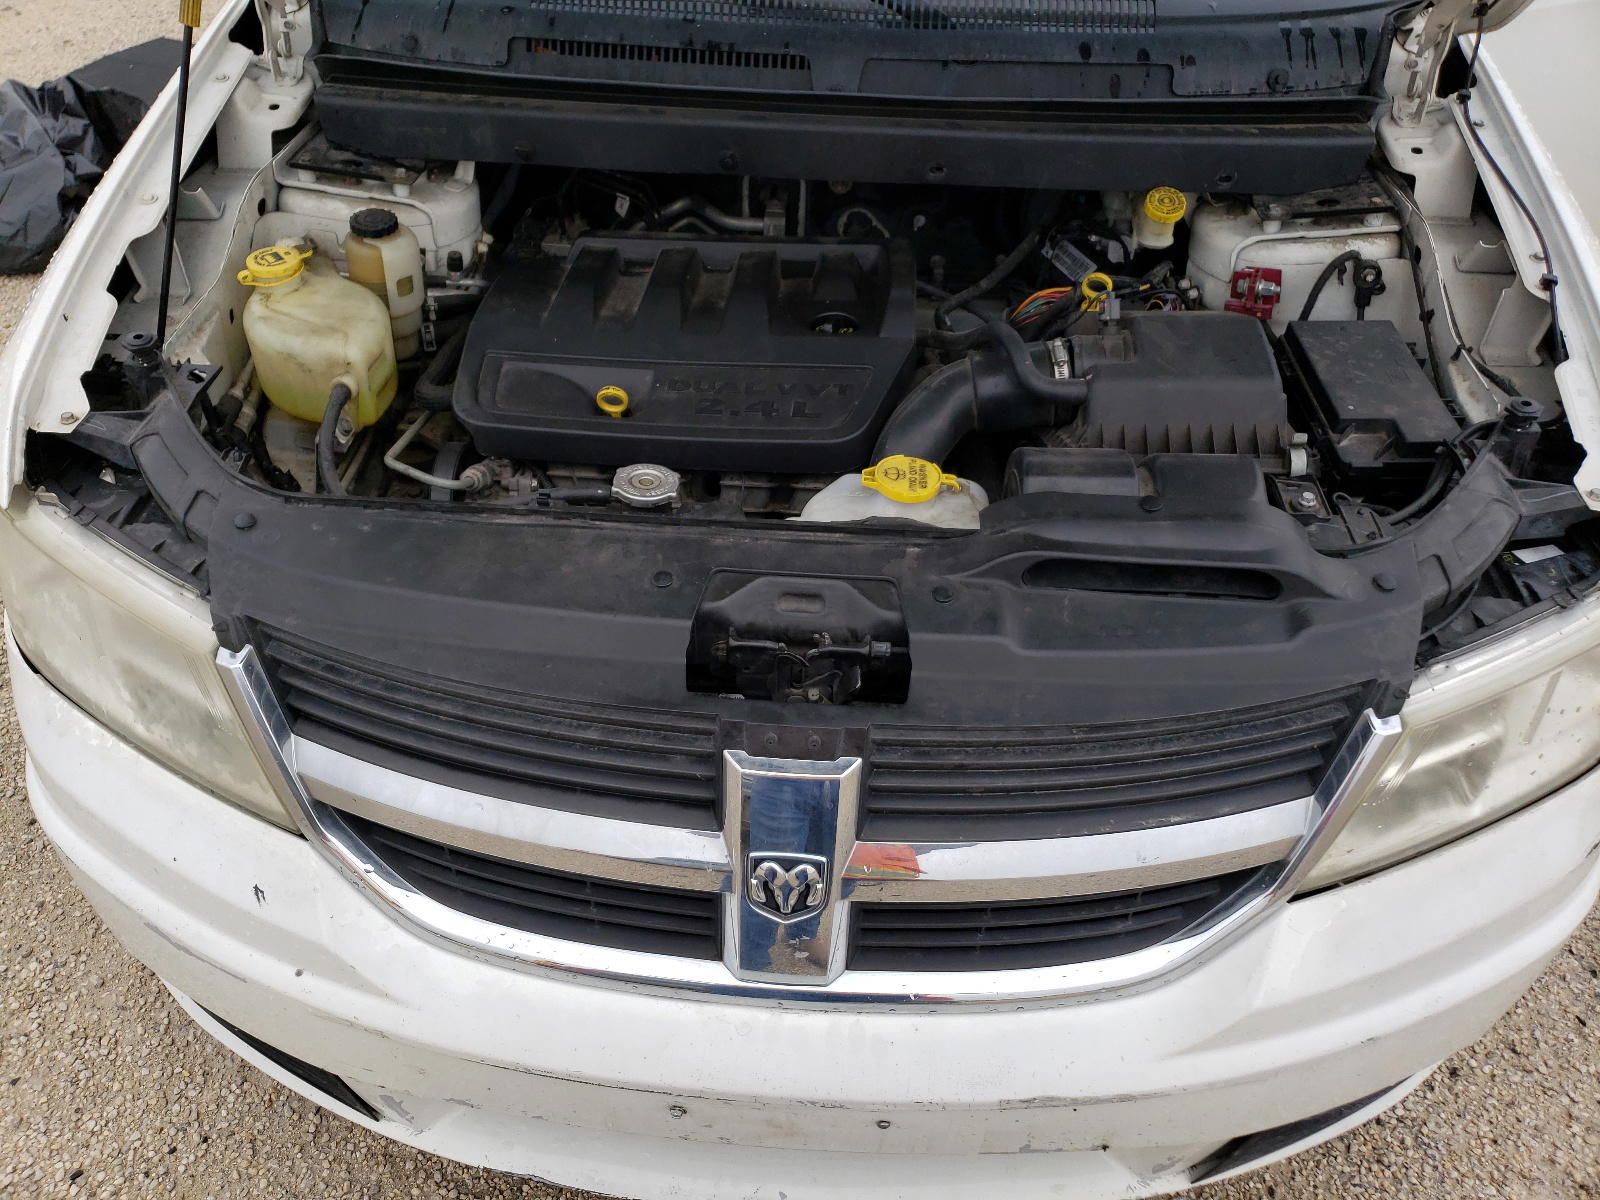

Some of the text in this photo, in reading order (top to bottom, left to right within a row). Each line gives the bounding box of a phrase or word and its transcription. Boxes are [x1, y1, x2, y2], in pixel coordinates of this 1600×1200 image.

[667, 377, 854, 397] DUAL VVT
[695, 398, 824, 418] 2.4L
[908, 476, 917, 493] ONLY
[918, 463, 928, 489] WASHER
